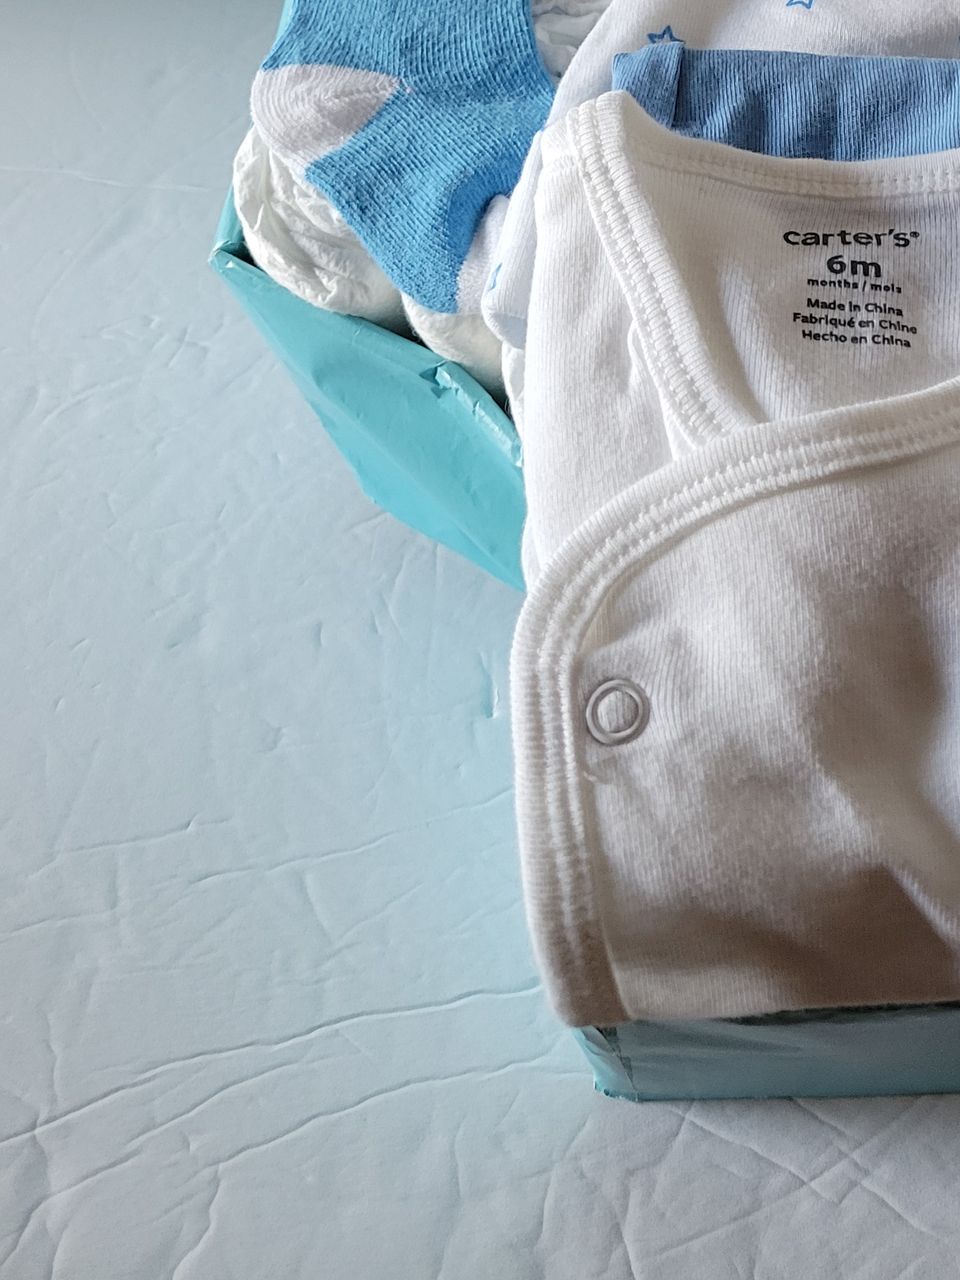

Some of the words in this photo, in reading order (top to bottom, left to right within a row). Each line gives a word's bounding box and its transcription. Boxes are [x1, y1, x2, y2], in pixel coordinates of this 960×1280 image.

[826, 254, 882, 278] 6m
[807, 278, 859, 290] months
[870, 283, 903, 294] mois
[806, 298, 846, 312] Made
[848, 301, 861, 313] in
[864, 302, 904, 318] China
[792, 311, 856, 329] Fabriqué
[857, 319, 875, 329] en
[878, 319, 917, 335] Chine
[801, 329, 848, 344] Hecho
[850, 335, 868, 344] en
[871, 334, 912, 348] China
